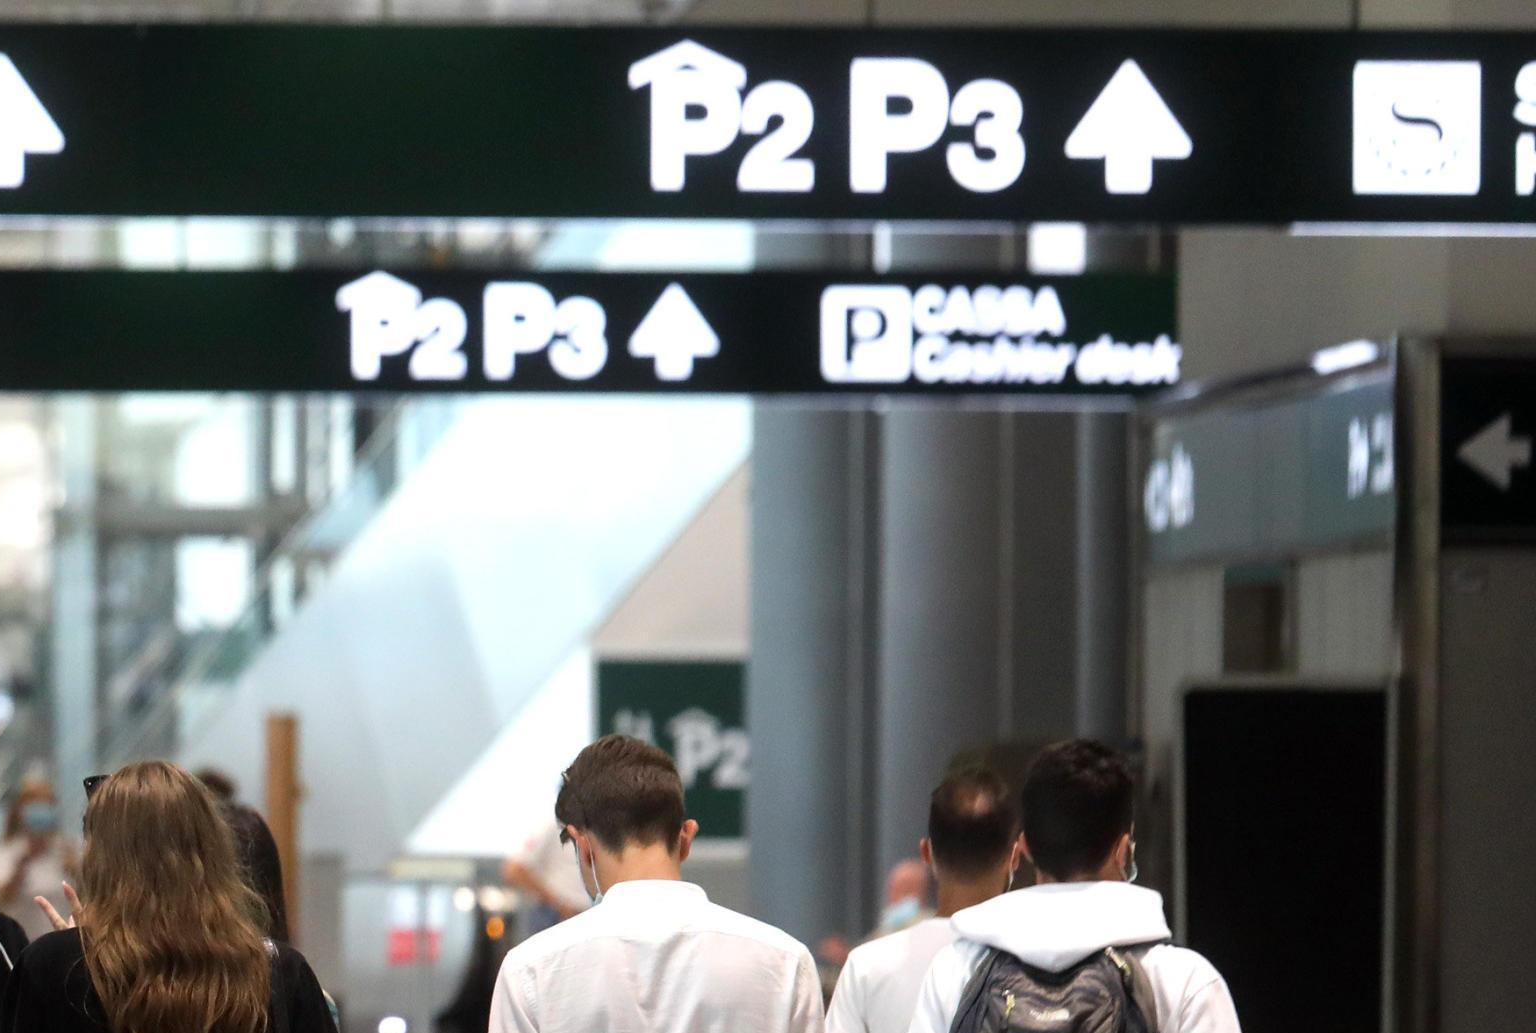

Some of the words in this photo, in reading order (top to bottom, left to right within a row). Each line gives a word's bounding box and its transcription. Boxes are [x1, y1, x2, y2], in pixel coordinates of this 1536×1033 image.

[640, 52, 815, 193] P2
[850, 57, 1026, 193] P3
[342, 280, 468, 381] P2
[482, 282, 608, 380] P3
